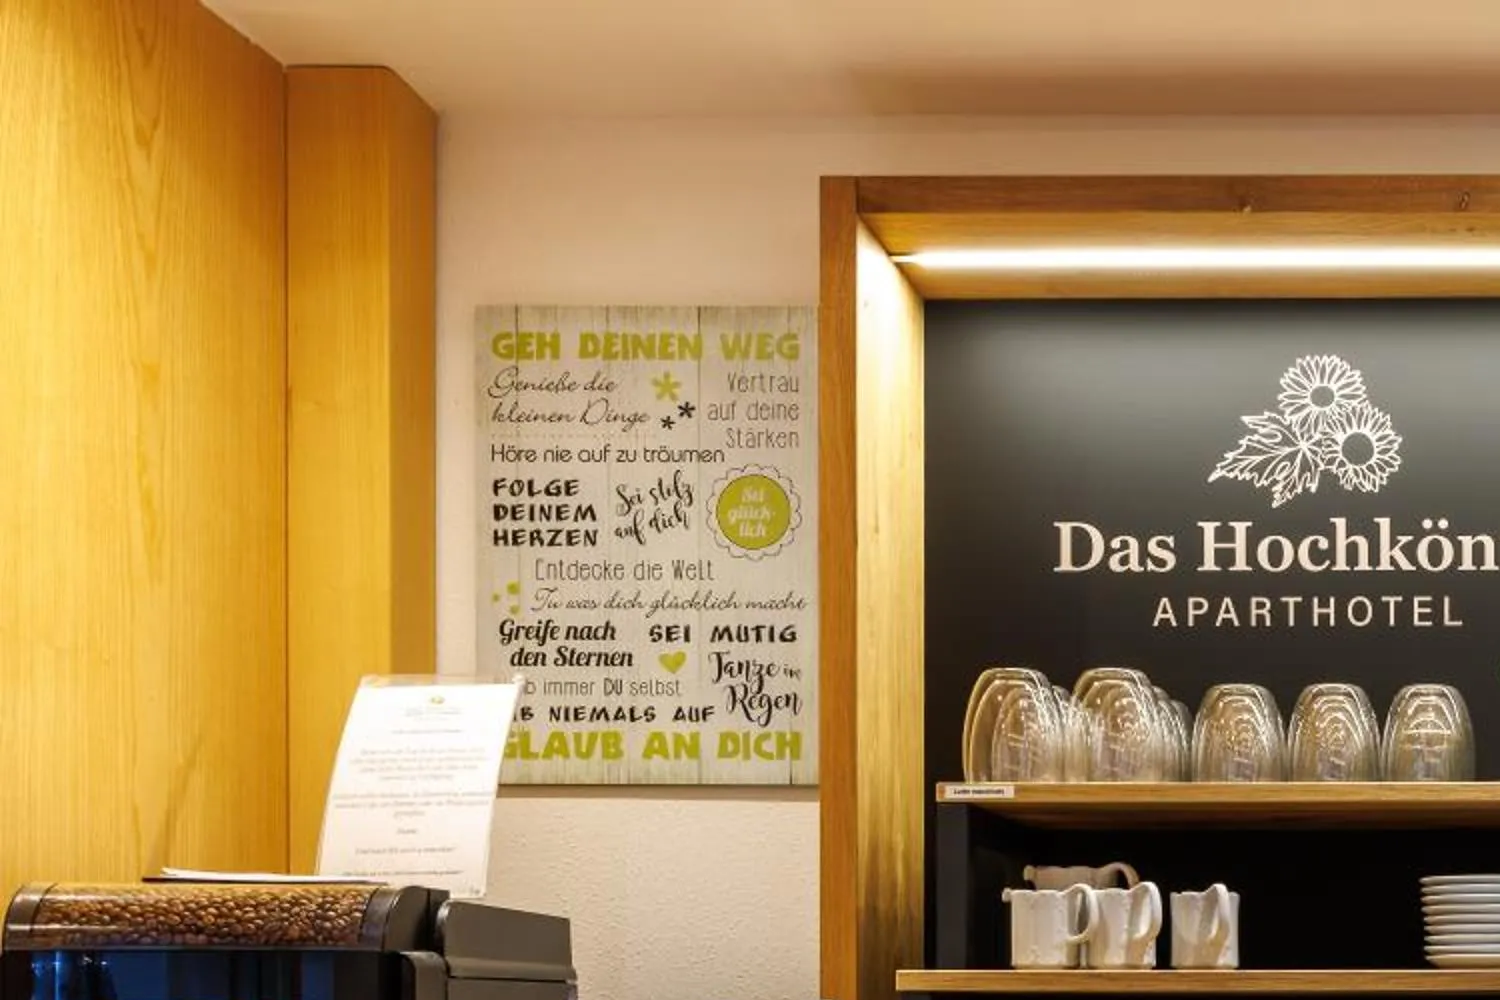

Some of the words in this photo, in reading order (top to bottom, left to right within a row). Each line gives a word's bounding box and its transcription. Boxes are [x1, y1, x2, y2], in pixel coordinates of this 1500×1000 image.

[491, 331, 562, 361] GEH
[578, 331, 704, 361] DEINEN
[719, 331, 800, 361] WEG
[487, 366, 581, 398] Genieße
[583, 372, 617, 393] die
[727, 372, 800, 393] Vertrau
[491, 402, 575, 423] kleinen
[579, 397, 650, 432] Dinge
[707, 400, 737, 421] auf
[747, 400, 800, 421] deine
[725, 427, 800, 449] Stärken
[491, 443, 538, 463] Höre
[543, 445, 571, 463] nie
[577, 445, 610, 463] auf
[616, 449, 637, 463] zu
[643, 444, 725, 464] träumen
[492, 478, 580, 497] FOLGE
[615, 483, 645, 516] Sei
[492, 504, 597, 522] DEINEM
[614, 512, 647, 546] auf
[648, 503, 690, 534] dich
[492, 529, 599, 547] HERZEN
[1053, 520, 1177, 574] Das
[534, 558, 625, 581] Entdecke
[633, 560, 663, 581] die
[671, 560, 715, 581] Welt
[531, 587, 561, 611] Tu
[565, 599, 599, 610] was
[602, 590, 644, 610] dich
[645, 590, 739, 618] glücklich
[744, 591, 808, 611] macht
[1152, 596, 1464, 628] APARTHOTEL
[499, 618, 560, 647] Greife
[565, 619, 616, 641] nach
[649, 624, 692, 644] SEI
[709, 624, 798, 643] MUTIG
[509, 646, 548, 668] den
[553, 645, 634, 668] Sternen
[707, 649, 781, 695] Tanze
[542, 679, 596, 697] immer
[603, 678, 624, 697] DU
[628, 678, 683, 697] selbst
[512, 705, 534, 722] IB
[548, 705, 657, 723] NIEMALS
[671, 705, 716, 722] AUF
[724, 682, 804, 728] Regen
[641, 731, 699, 761] AN
[716, 731, 804, 761] DICH
